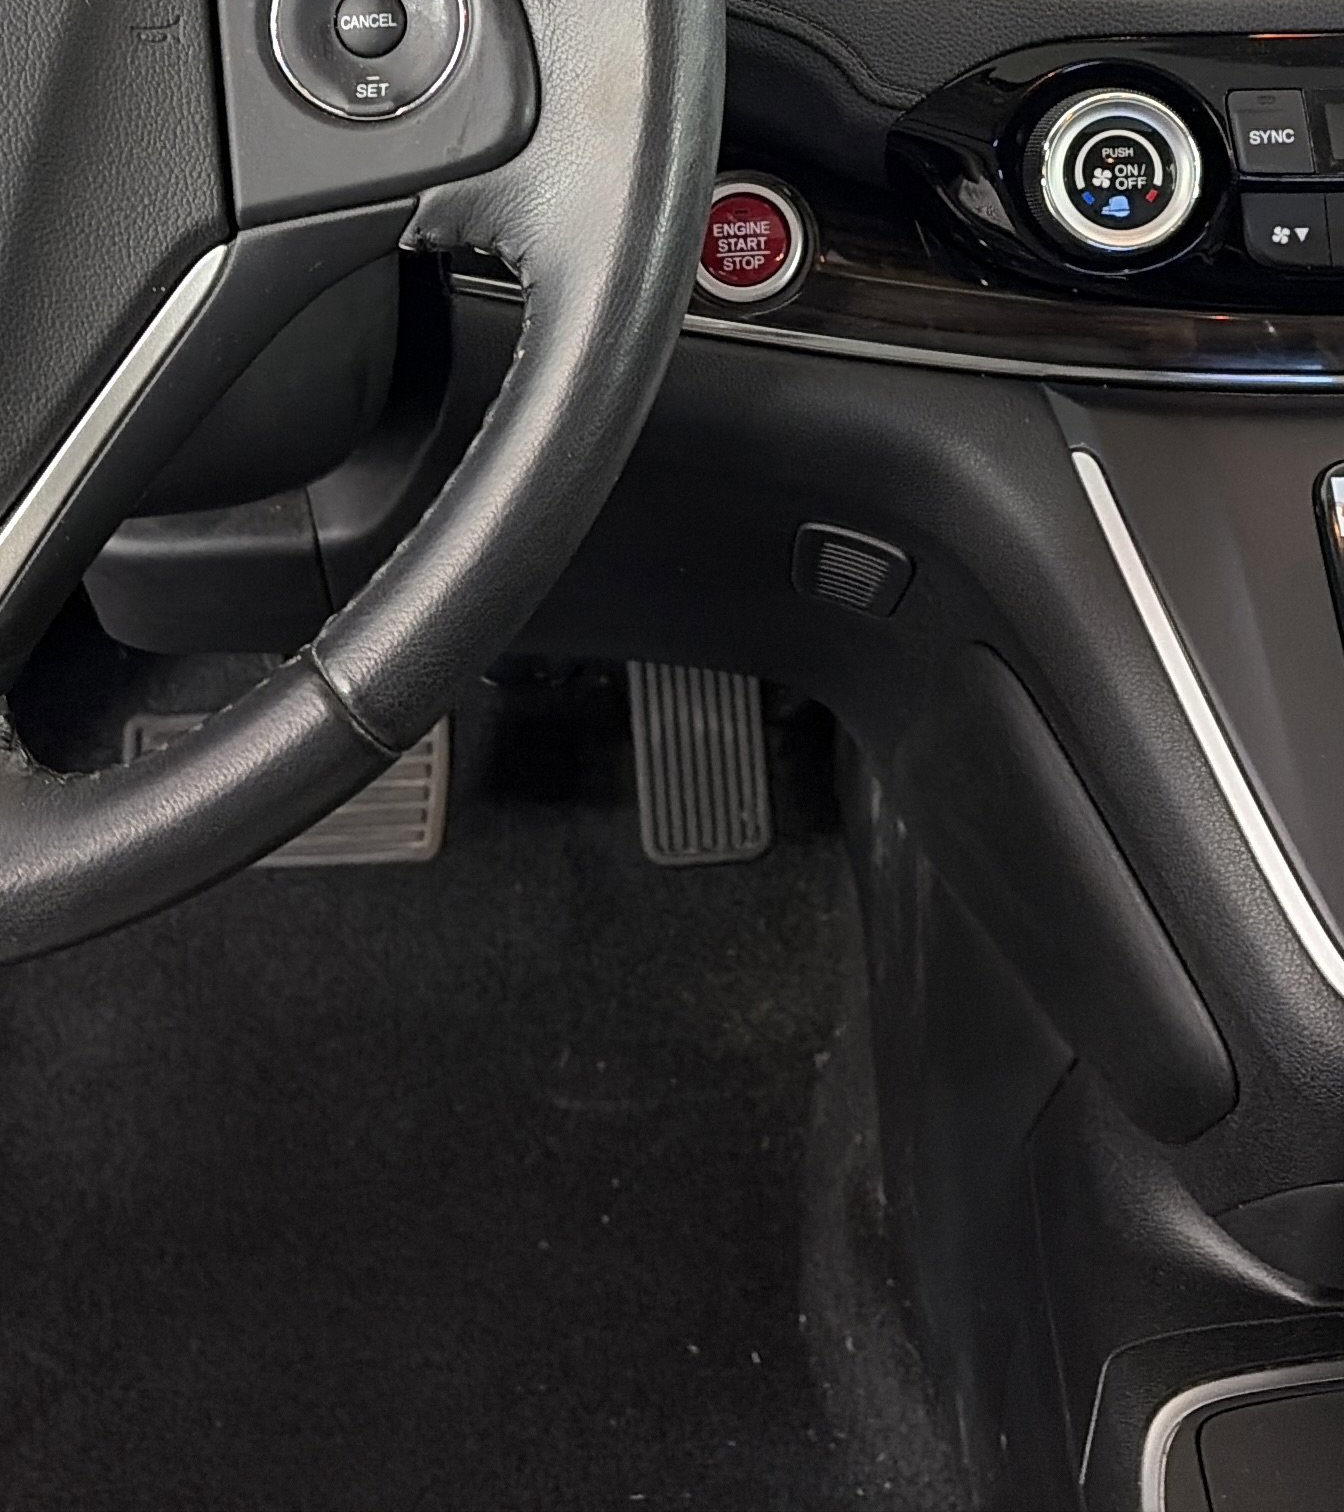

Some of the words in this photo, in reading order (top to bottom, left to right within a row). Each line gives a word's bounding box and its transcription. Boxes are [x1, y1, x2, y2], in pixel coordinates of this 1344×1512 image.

[340, 13, 397, 31] CANCEL
[356, 83, 390, 99] SET
[1249, 128, 1295, 146] SYNC
[1102, 147, 1134, 158] PUSH
[1115, 176, 1147, 190] OFF
[712, 220, 771, 237] ENGINE
[718, 237, 767, 253] START
[723, 255, 765, 271] STOP
